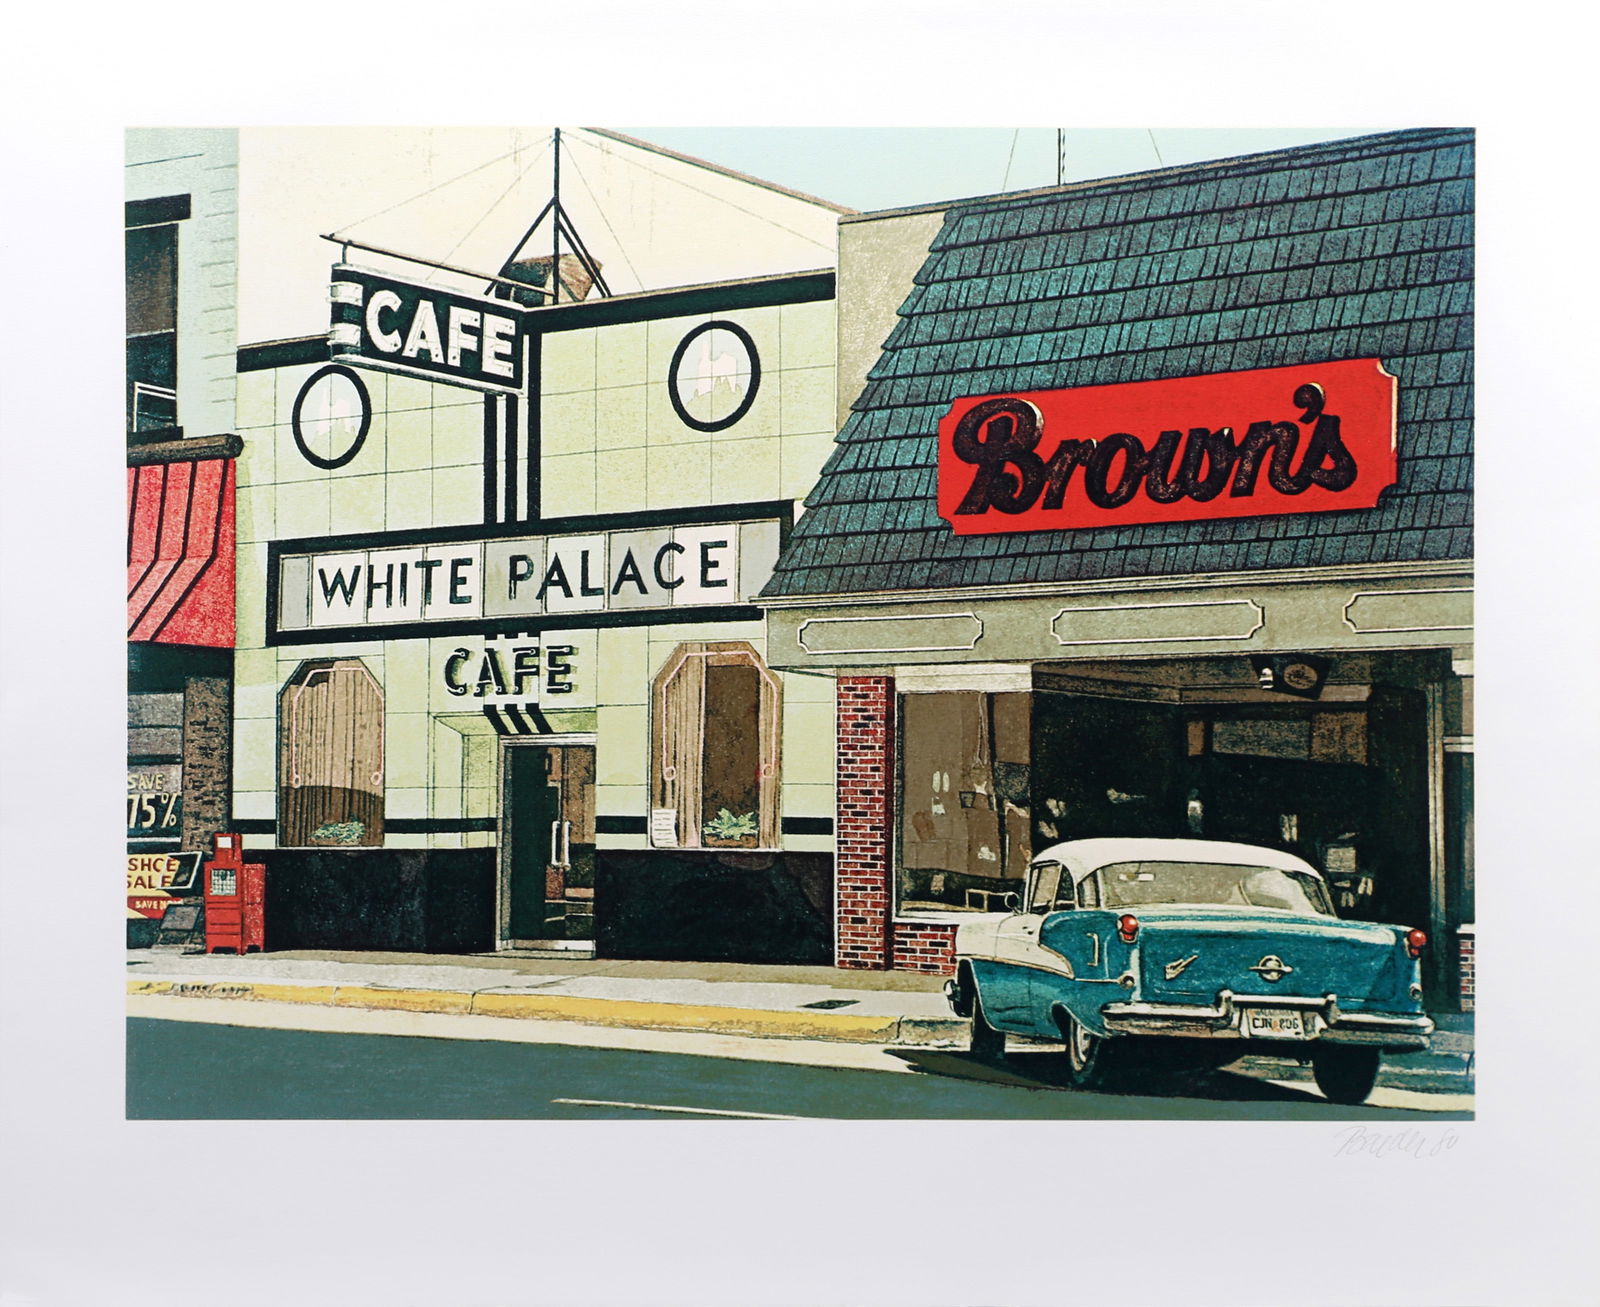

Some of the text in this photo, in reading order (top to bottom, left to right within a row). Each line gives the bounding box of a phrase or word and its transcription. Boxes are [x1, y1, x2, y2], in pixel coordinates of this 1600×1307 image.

[366, 290, 516, 379] CAFE
[952, 382, 1358, 516] Brown's
[317, 540, 729, 609] WHITE PALACE
[444, 644, 574, 698] CAFE
[127, 773, 165, 790] SAVE
[127, 792, 177, 828] 75%
